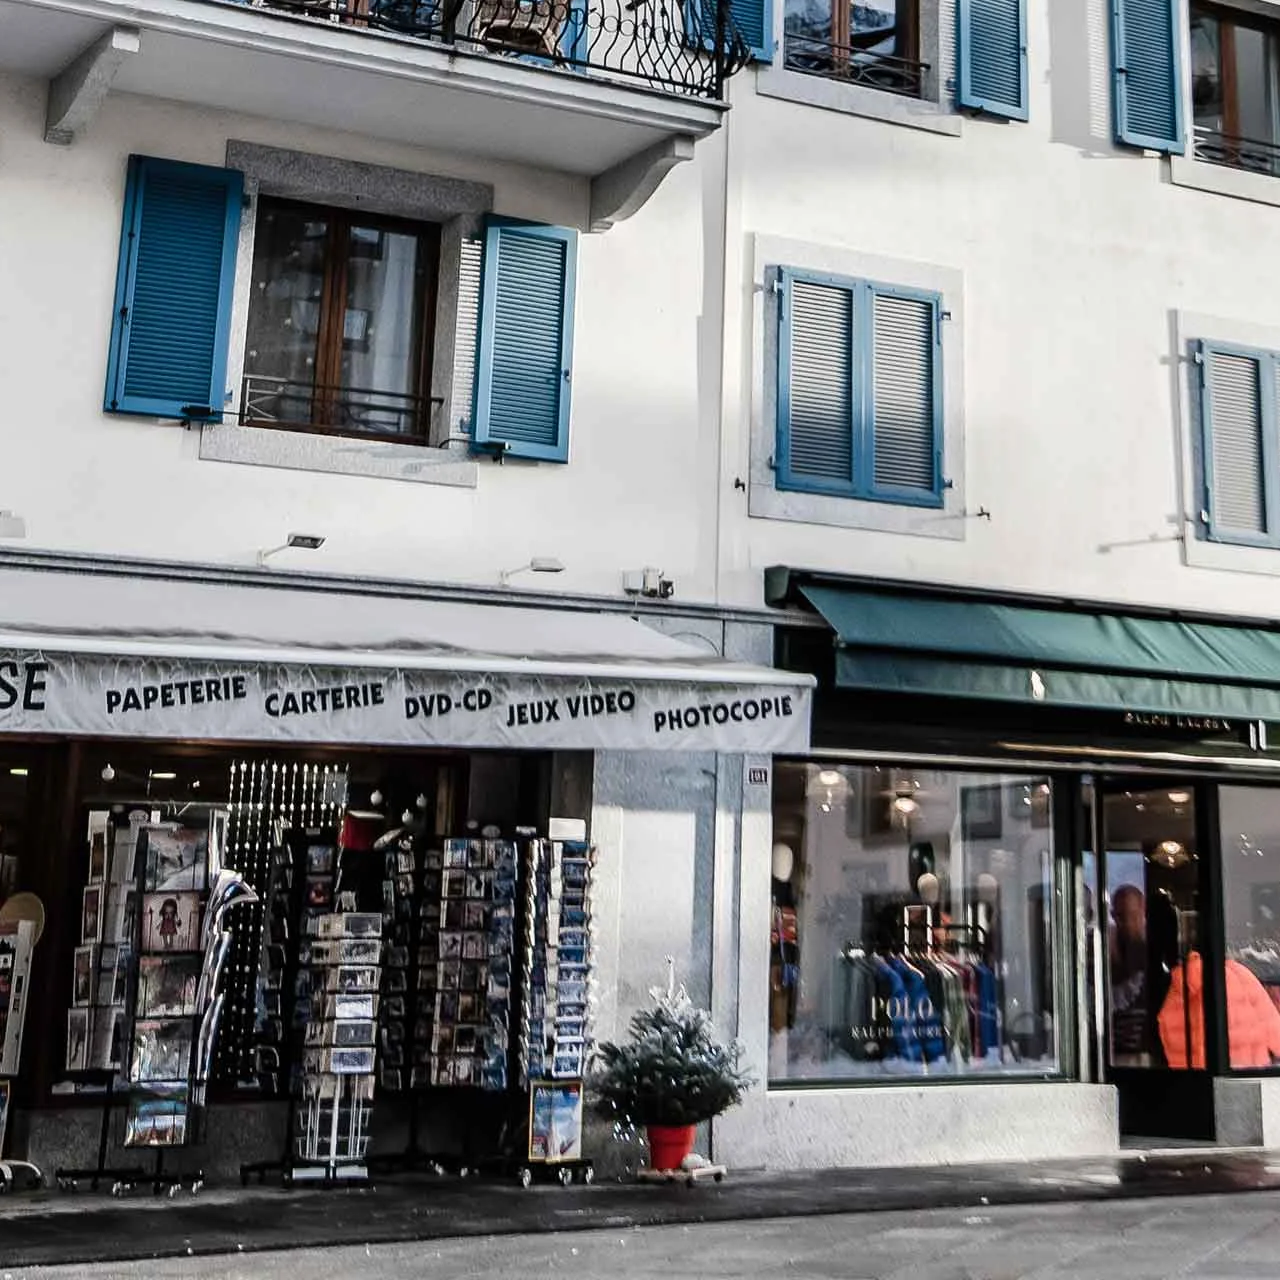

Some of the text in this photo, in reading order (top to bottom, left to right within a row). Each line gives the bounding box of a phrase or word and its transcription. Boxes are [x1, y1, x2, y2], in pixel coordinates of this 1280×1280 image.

[106, 676, 247, 714] PAPETERIE
[264, 682, 384, 717] CARTERIE
[405, 688, 492, 719] DVD-CD
[506, 690, 636, 728] JEUX VIDEO
[654, 695, 793, 733] PHOTOCOPIE
[871, 993, 935, 1021] POLO
